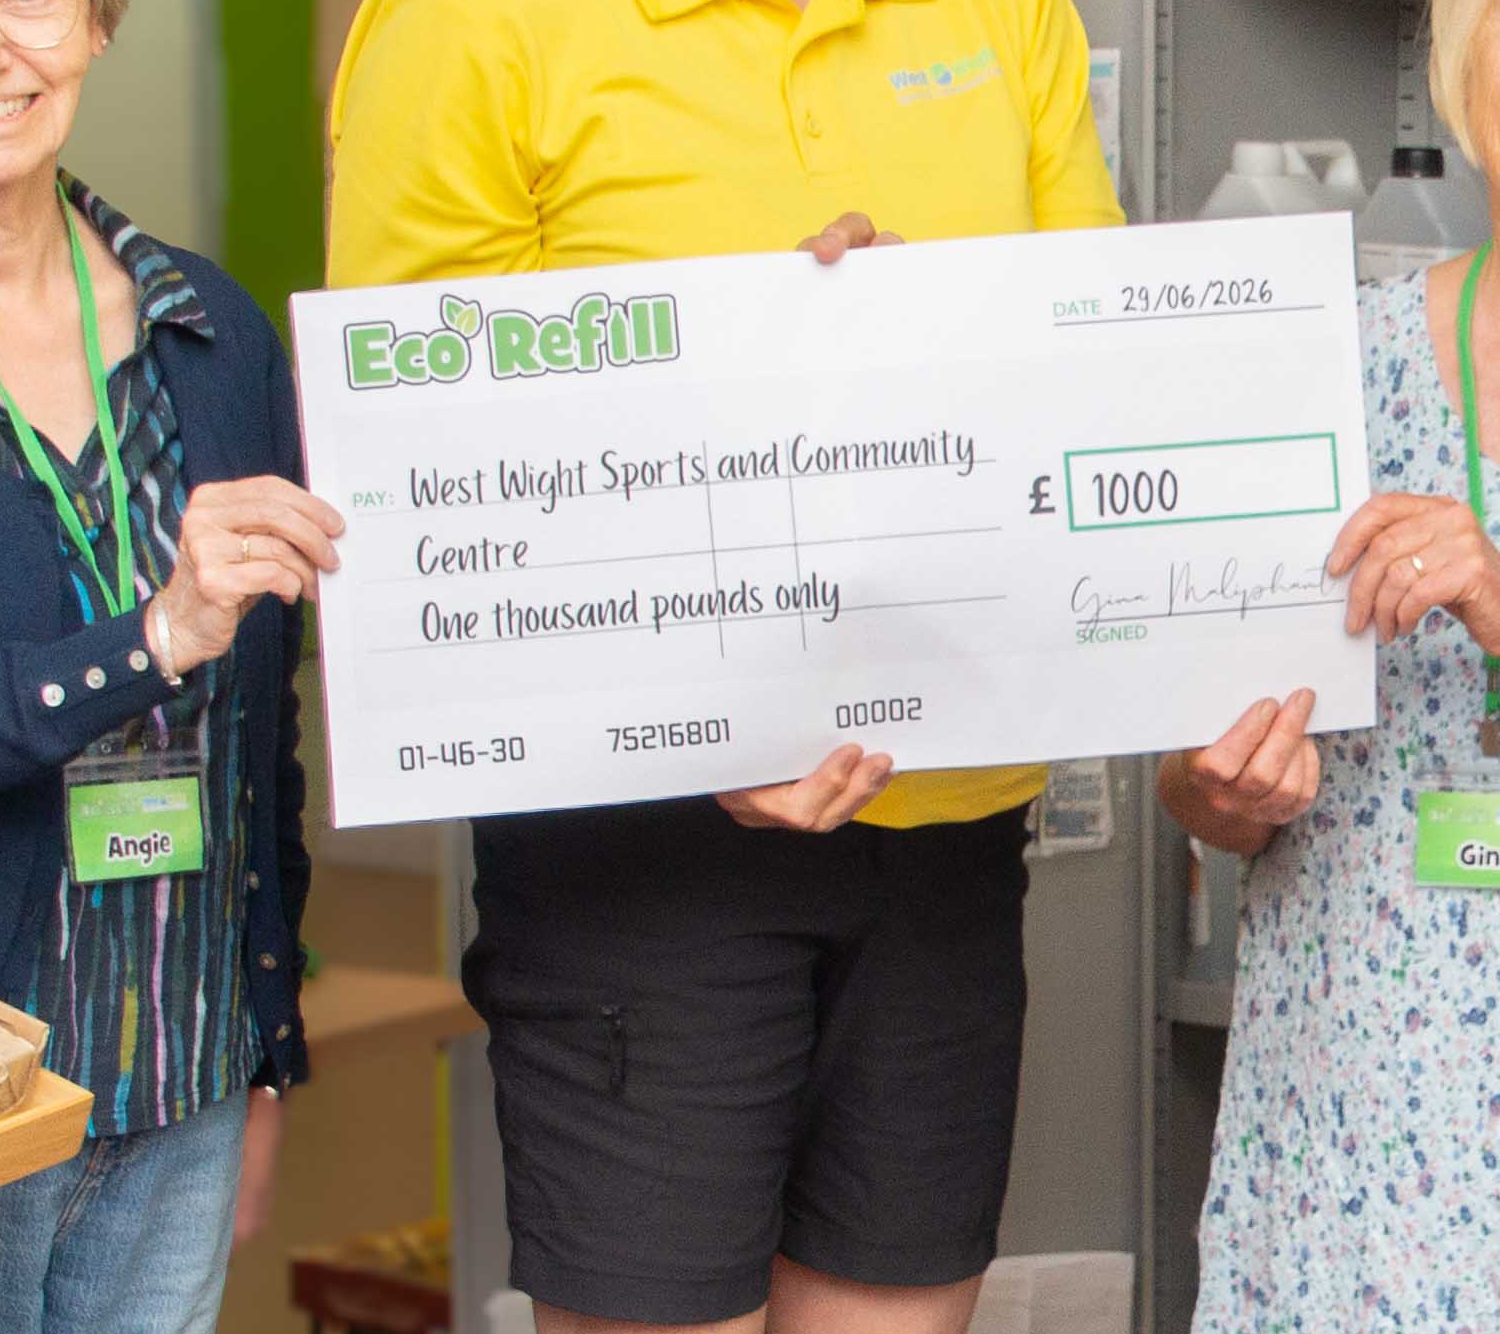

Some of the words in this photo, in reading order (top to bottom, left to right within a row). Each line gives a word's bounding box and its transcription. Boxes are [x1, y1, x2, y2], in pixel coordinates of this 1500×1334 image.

[1053, 298, 1102, 318] DATE
[1121, 277, 1275, 314] 29/06/2026
[344, 321, 472, 391] Eco
[488, 292, 681, 379] Refill
[352, 489, 396, 509] PAY:
[410, 465, 487, 509] West
[498, 456, 589, 514] Wight
[602, 449, 705, 501] Sports
[716, 439, 781, 481] and
[791, 427, 977, 478] Community
[1028, 477, 1058, 515] £
[1092, 470, 1180, 519] 1000
[416, 533, 530, 577] Centre
[421, 601, 484, 644] One
[492, 585, 639, 637] thousand
[650, 583, 768, 633] pounds
[775, 572, 843, 625] only
[1076, 624, 1148, 645] SIGNED
[835, 697, 924, 730] 00002
[398, 734, 527, 773] 01-46-30
[605, 716, 733, 754] 75216801
[108, 832, 171, 864] Angie
